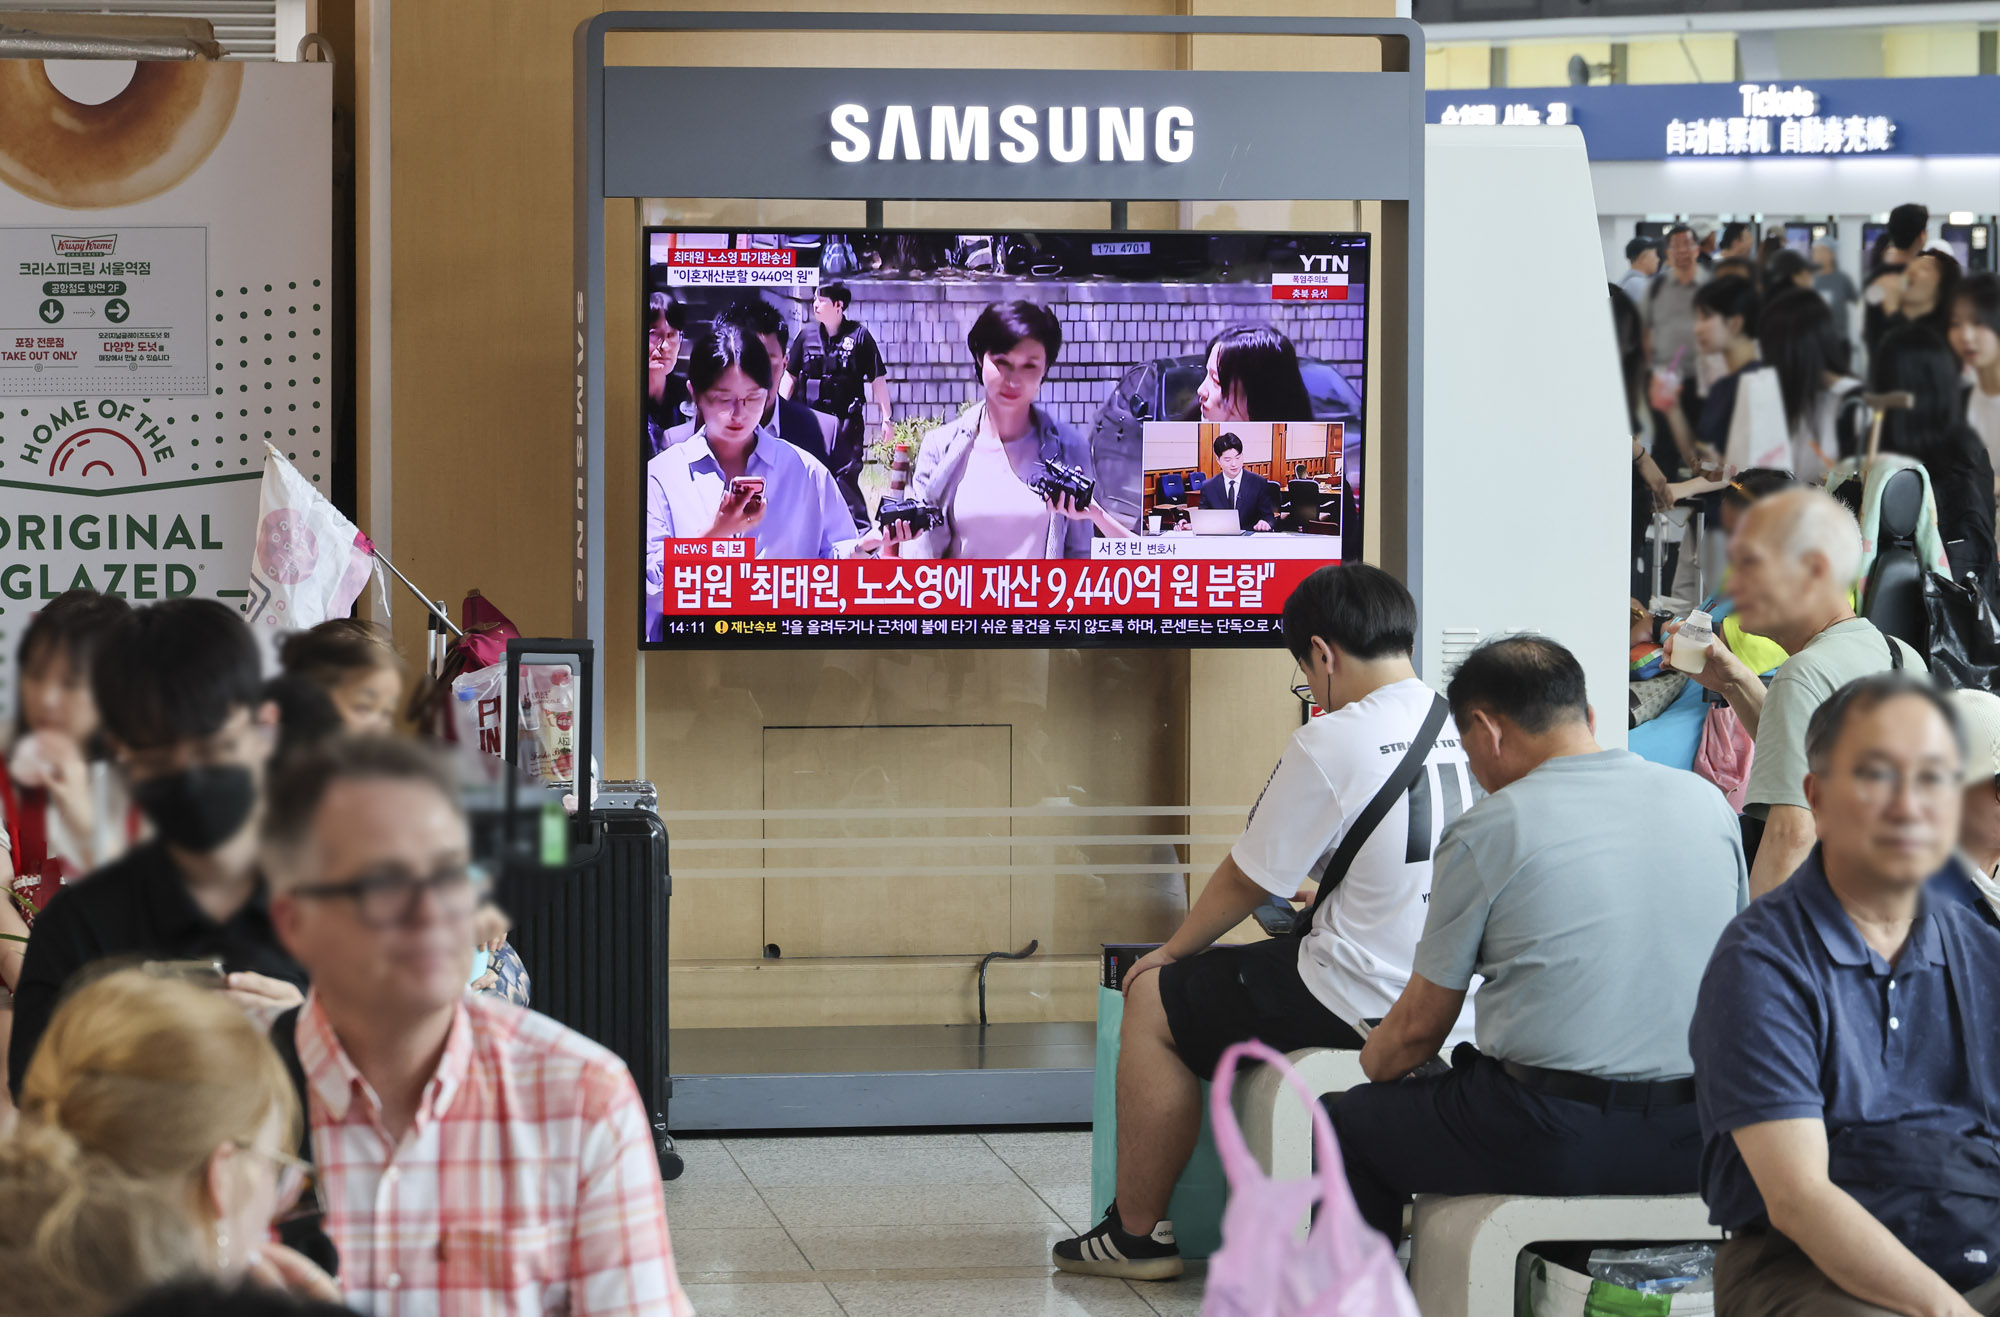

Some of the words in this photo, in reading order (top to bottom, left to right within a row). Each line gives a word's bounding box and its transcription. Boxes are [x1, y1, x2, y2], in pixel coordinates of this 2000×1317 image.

[1739, 84, 1815, 117] Tickets
[830, 103, 1194, 163] SAMSUNG
[57, 240, 86, 251] Krispy
[85, 240, 113, 250] Kreme
[1121, 244, 1145, 253] 4701
[674, 251, 704, 265] 최태원
[707, 251, 738, 265] 노소영
[740, 251, 791, 265] 파기환송심
[1300, 254, 1349, 272] YTN
[20, 262, 95, 276] 크리스피크림
[99, 262, 151, 276] 서울역점
[752, 270, 793, 283] 9440억
[52, 283, 86, 293] 공항철도
[88, 283, 106, 293] 방면
[108, 284, 120, 293] 2F
[16, 337, 34, 348] 포장
[37, 337, 64, 348] 전문점
[104, 342, 135, 352] 다양한
[1, 351, 26, 360] TAKE
[29, 351, 49, 360] OUT
[52, 351, 78, 360] ONLY
[20, 400, 89, 464] HOME
[98, 399, 135, 422] OF
[135, 413, 175, 463] THE
[576, 291, 584, 602] SAMSUNG
[674, 544, 708, 555] NEWS
[1147, 543, 1176, 555] 변호사
[1, 564, 196, 600] GLAZED
[674, 564, 733, 609] 법원
[854, 564, 973, 609] 노소영에
[980, 564, 1041, 609] 재산
[1047, 564, 1161, 613] 9,440억
[1170, 564, 1198, 608] 원
[669, 621, 705, 634] 14:11
[731, 620, 777, 634] 재난속보
[807, 620, 875, 635] 올려두거나
[877, 620, 918, 635] 근처에
[921, 620, 948, 635] 불에
[951, 619, 978, 634] 타기
[981, 619, 1008, 635] 쉬운
[1011, 619, 1051, 635] 물건을
[1054, 619, 1081, 634] 두지
[1084, 619, 1124, 634] 않도록
[1127, 619, 1157, 635] 하며,
[1160, 619, 1214, 634] 콘센트는
[1217, 619, 1270, 634] 단독으로
[1440, 740, 1456, 749] TO
